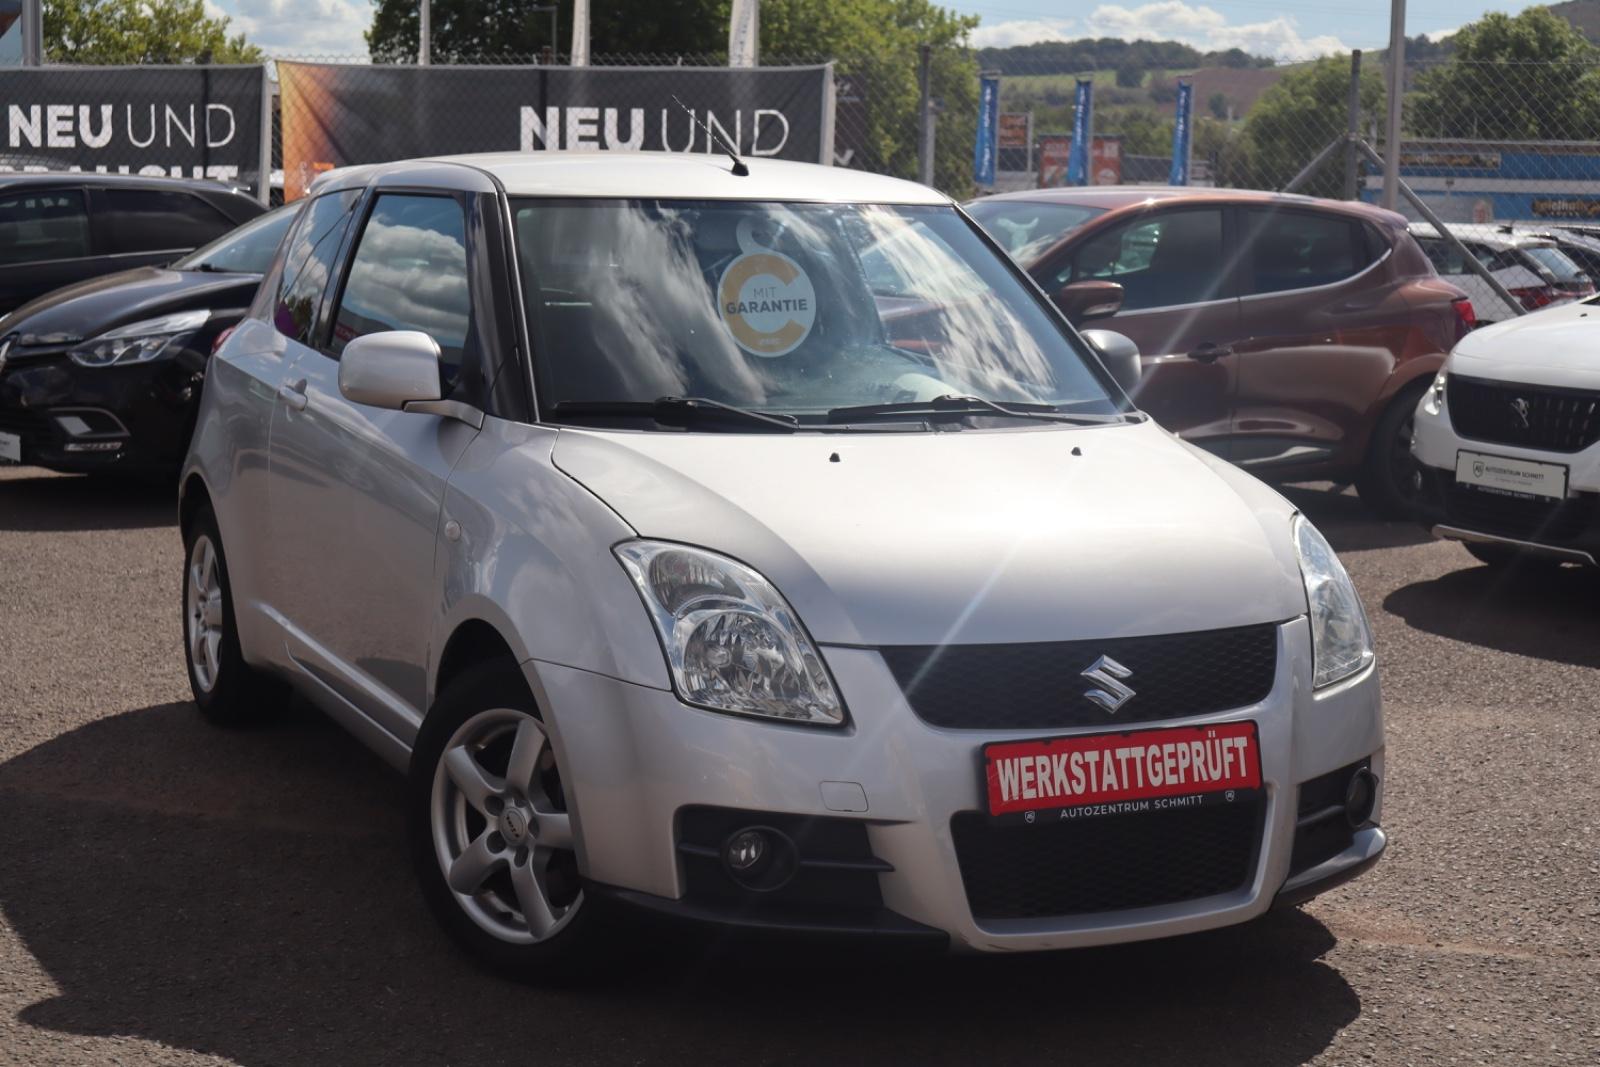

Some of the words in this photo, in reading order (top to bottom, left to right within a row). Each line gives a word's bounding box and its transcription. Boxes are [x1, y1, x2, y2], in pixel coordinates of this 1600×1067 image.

[8, 104, 113, 148] NEU
[126, 103, 236, 147] UND
[519, 106, 645, 151] NEU
[661, 108, 790, 156] UND
[726, 299, 808, 315] GARANTIE
[753, 286, 777, 299] MIT
[996, 731, 1249, 802] WERKSTATTGEPRÜFT
[1060, 801, 1149, 819] AUTOZENTRUM
[1154, 795, 1204, 810] SCHMITT
